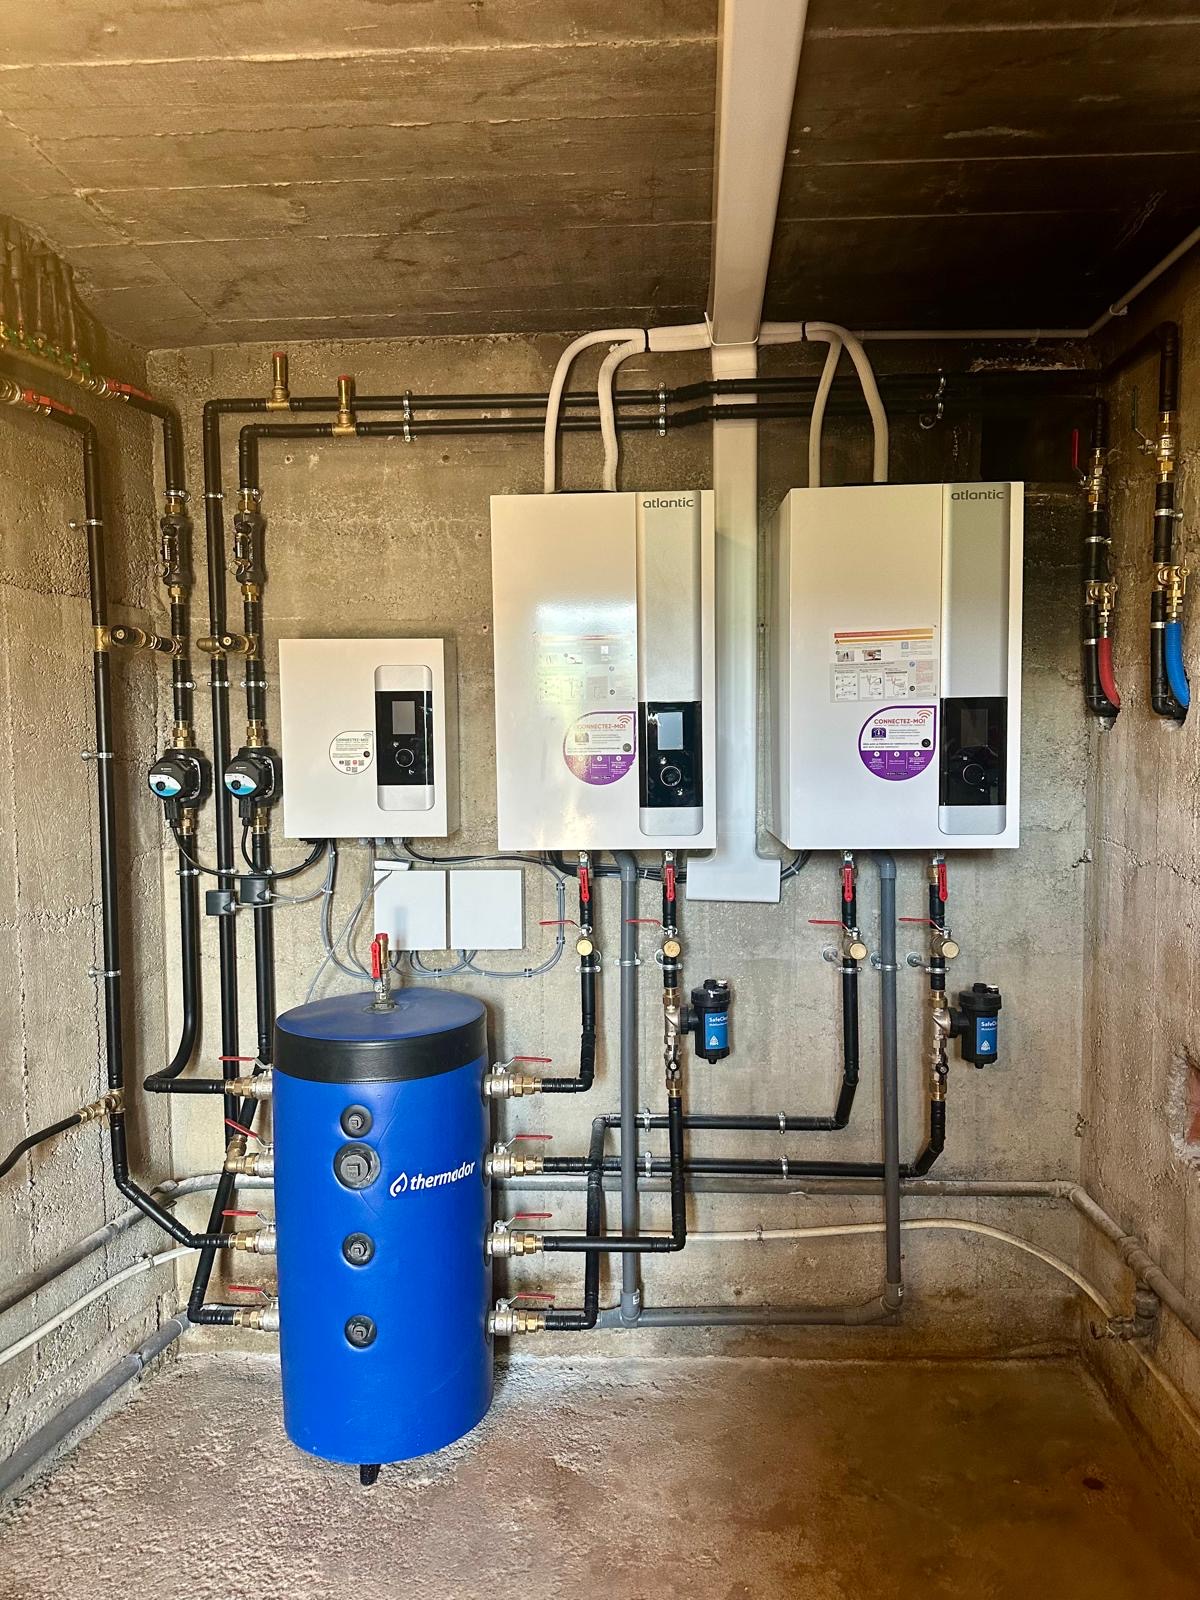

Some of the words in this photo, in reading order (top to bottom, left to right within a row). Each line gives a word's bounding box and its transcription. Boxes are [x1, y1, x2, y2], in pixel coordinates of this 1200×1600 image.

[951, 489, 1004, 500] atlantic
[643, 497, 694, 508] atlantic
[410, 1161, 476, 1191] thermador
